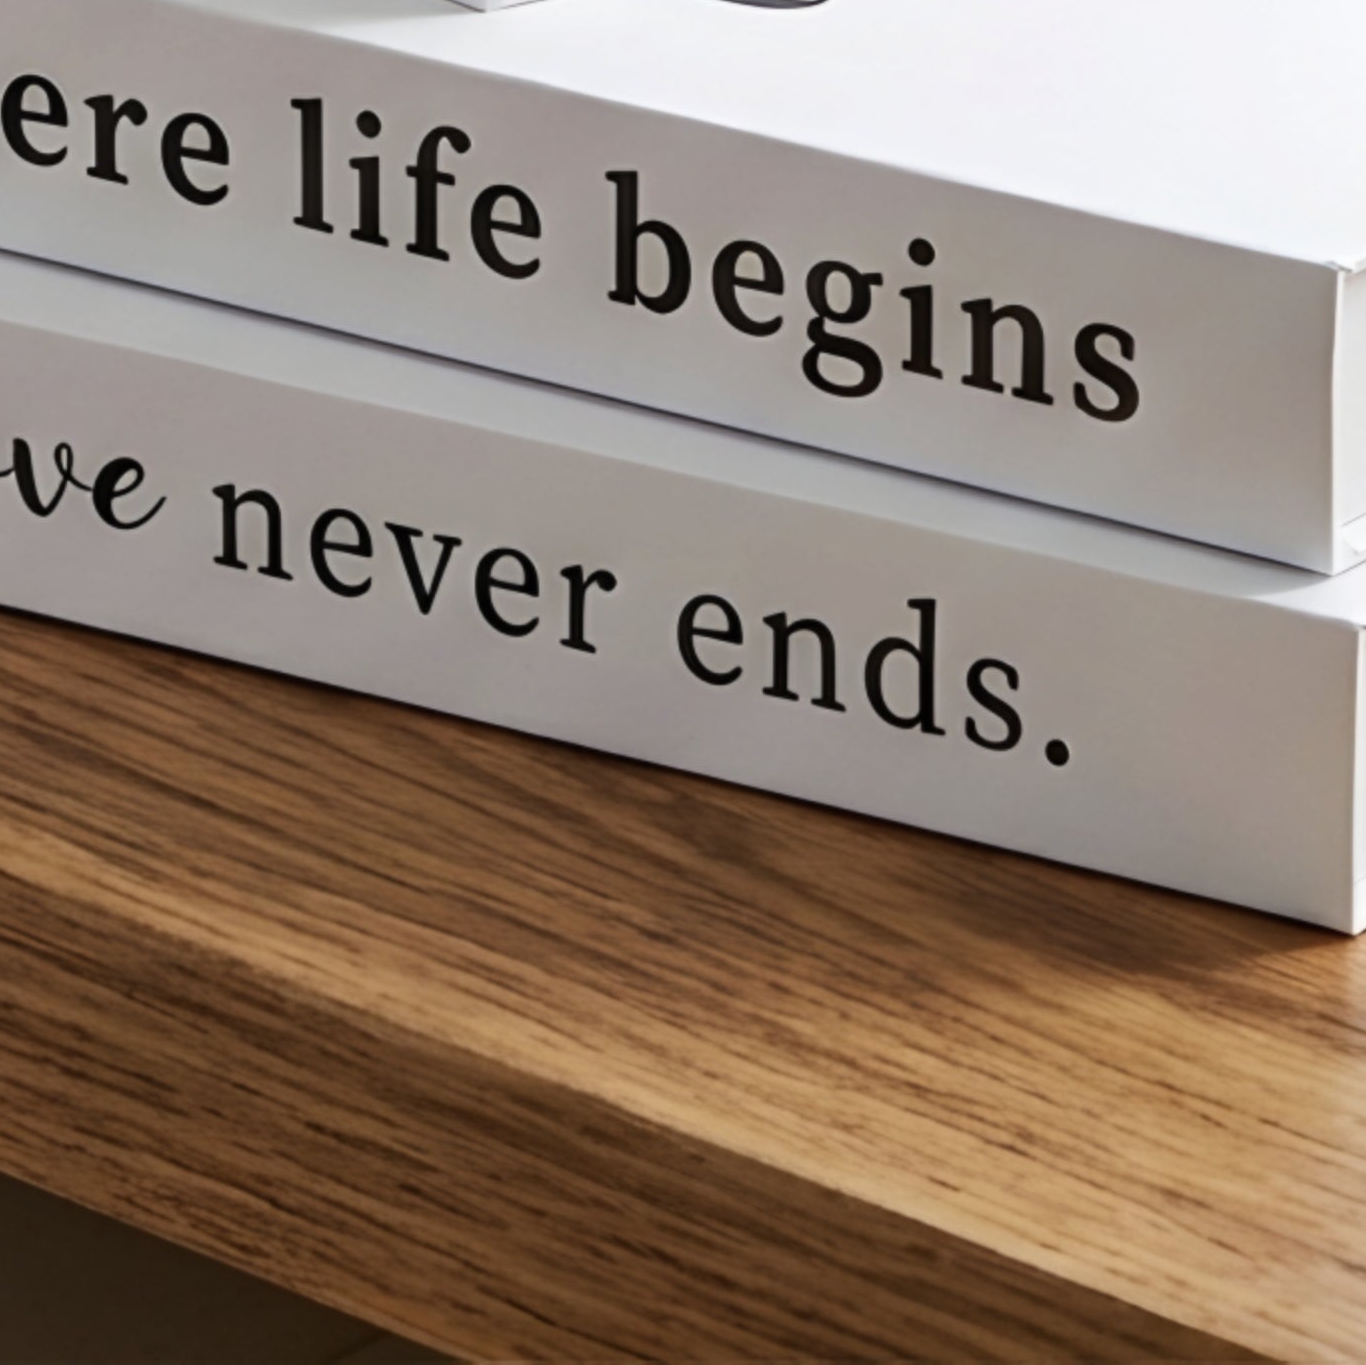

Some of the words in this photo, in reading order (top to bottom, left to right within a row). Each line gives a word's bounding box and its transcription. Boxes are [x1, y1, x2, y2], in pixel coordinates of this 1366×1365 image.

[289, 96, 543, 281] life
[603, 169, 1141, 424] begins
[210, 482, 619, 655] never
[675, 593, 1071, 768] ends.
